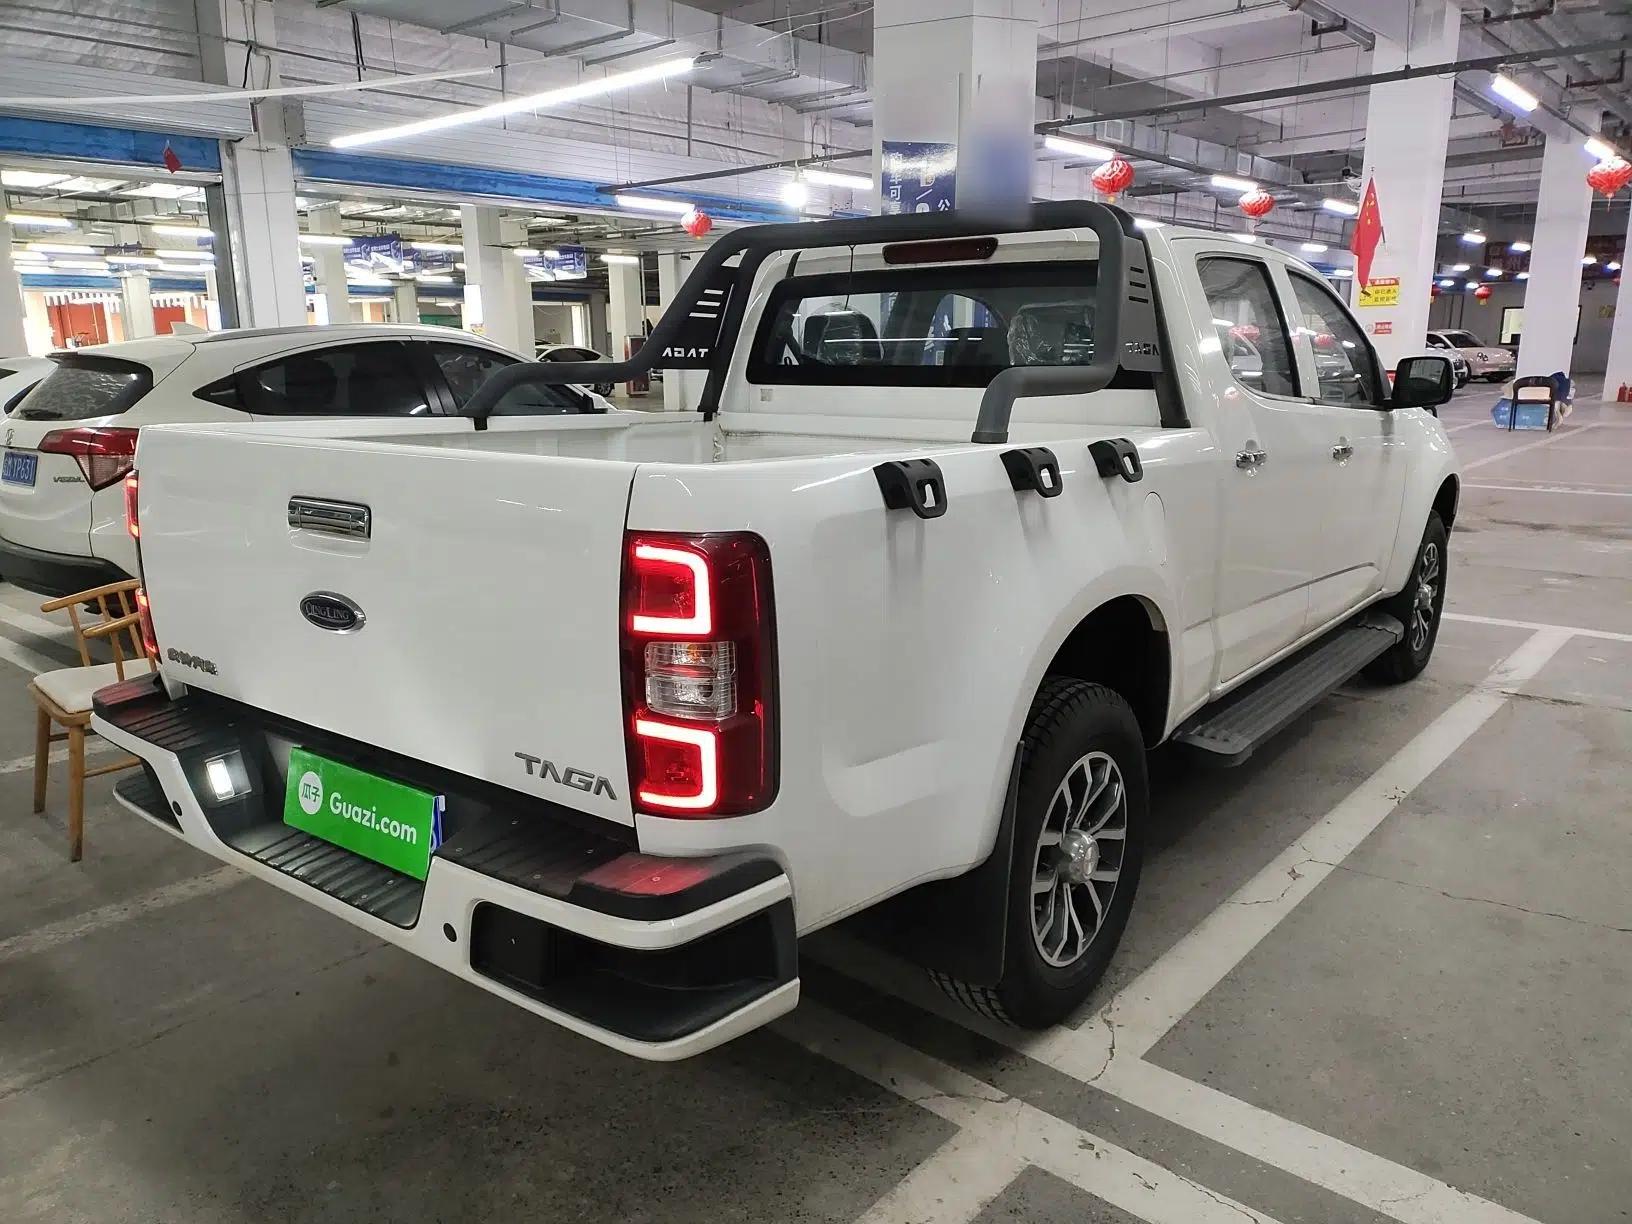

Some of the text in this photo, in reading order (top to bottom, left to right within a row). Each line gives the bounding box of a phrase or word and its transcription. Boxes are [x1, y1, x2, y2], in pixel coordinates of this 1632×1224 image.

[302, 782, 320, 802] 瓜子
[515, 751, 617, 800] TAGA
[330, 792, 417, 845] Guazi.com
